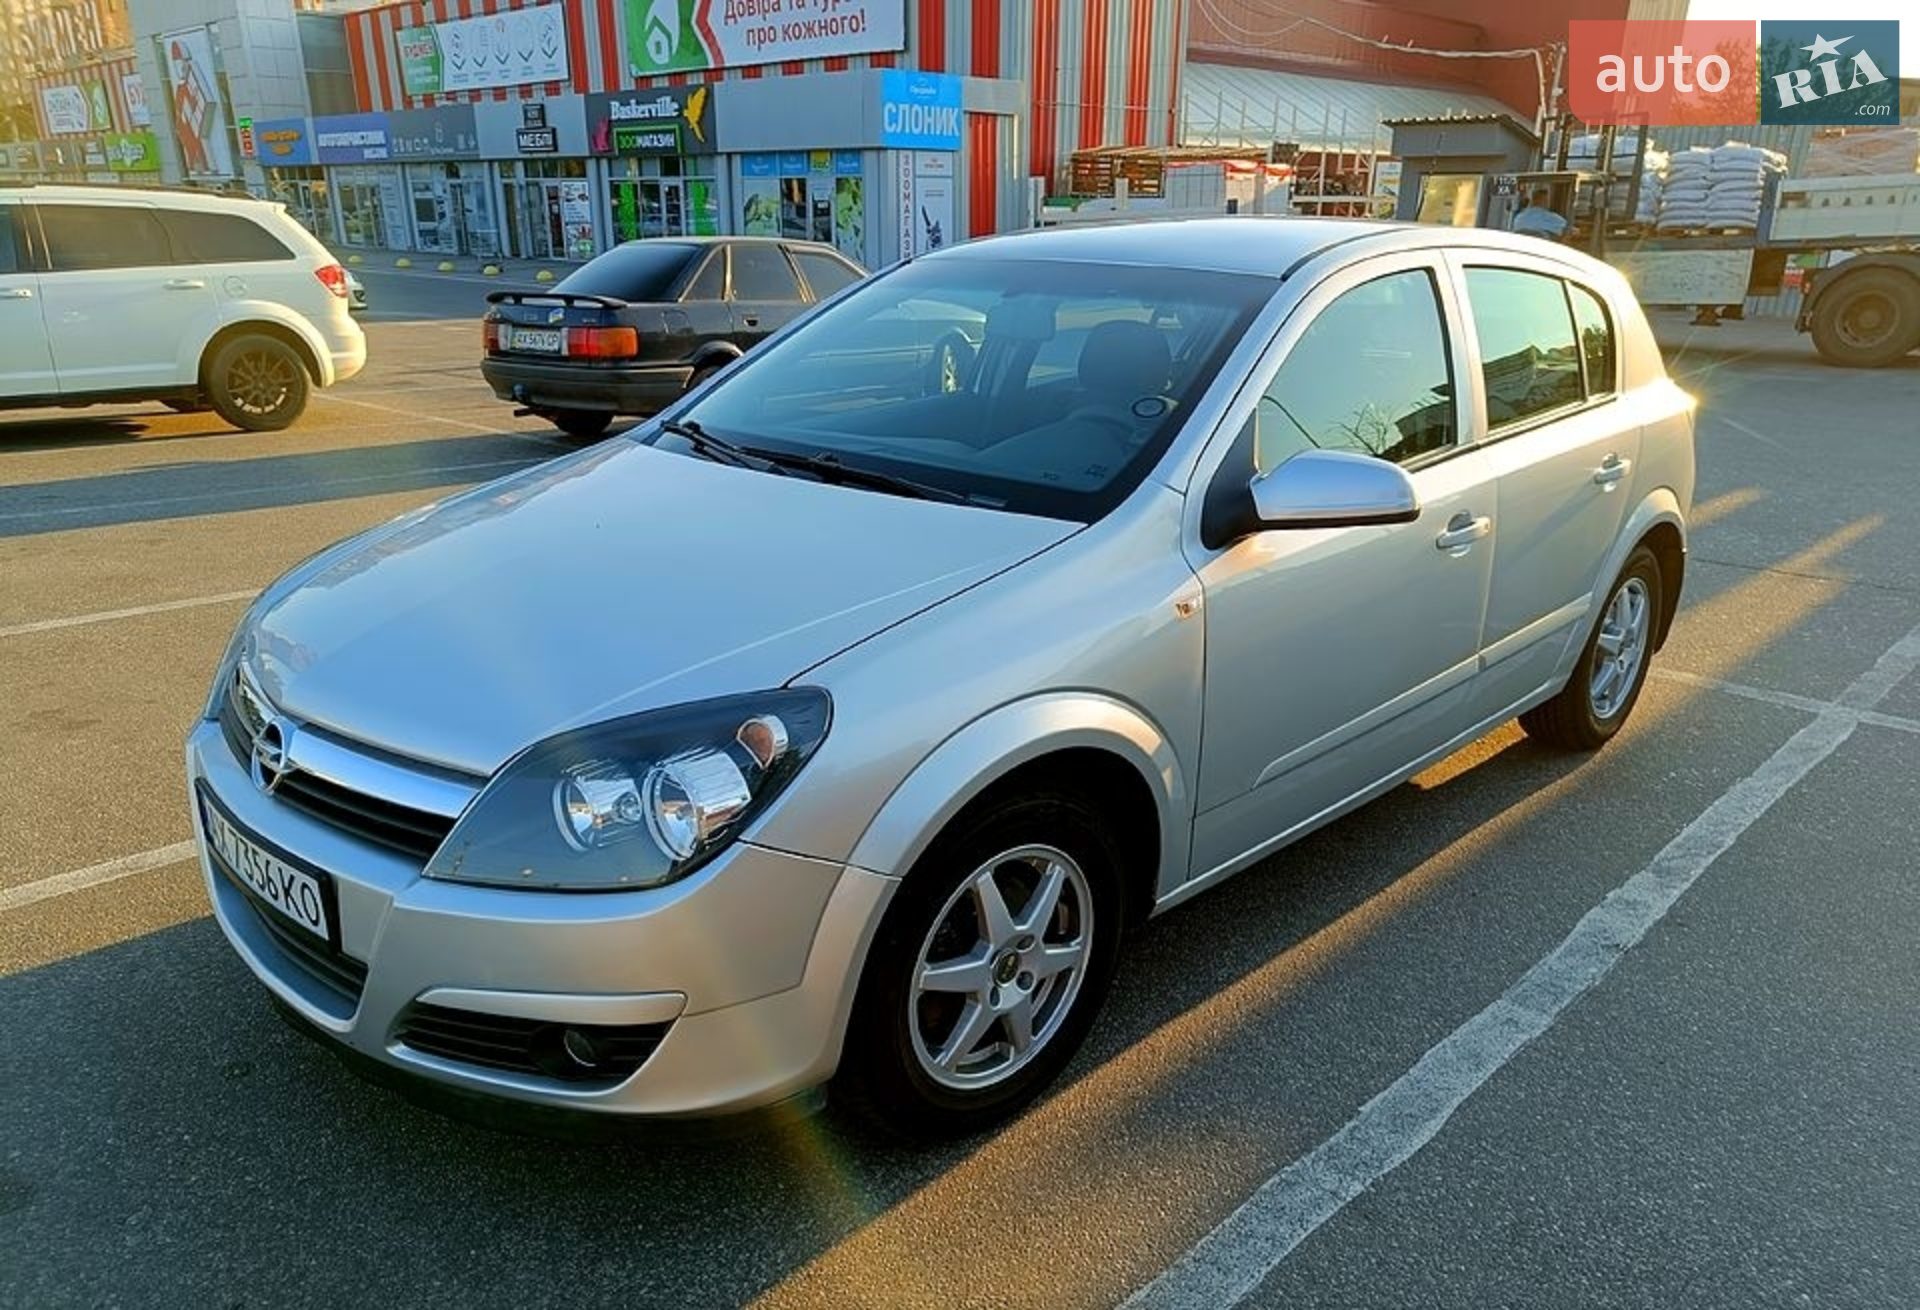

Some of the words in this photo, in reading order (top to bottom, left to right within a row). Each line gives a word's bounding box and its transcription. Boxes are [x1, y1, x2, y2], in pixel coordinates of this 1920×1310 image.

[724, 0, 782, 25] Довіра
[747, 26, 777, 50] про
[782, 8, 867, 43] кожного!
[610, 95, 680, 120] Baskerville
[883, 102, 960, 137] СЛОНИК
